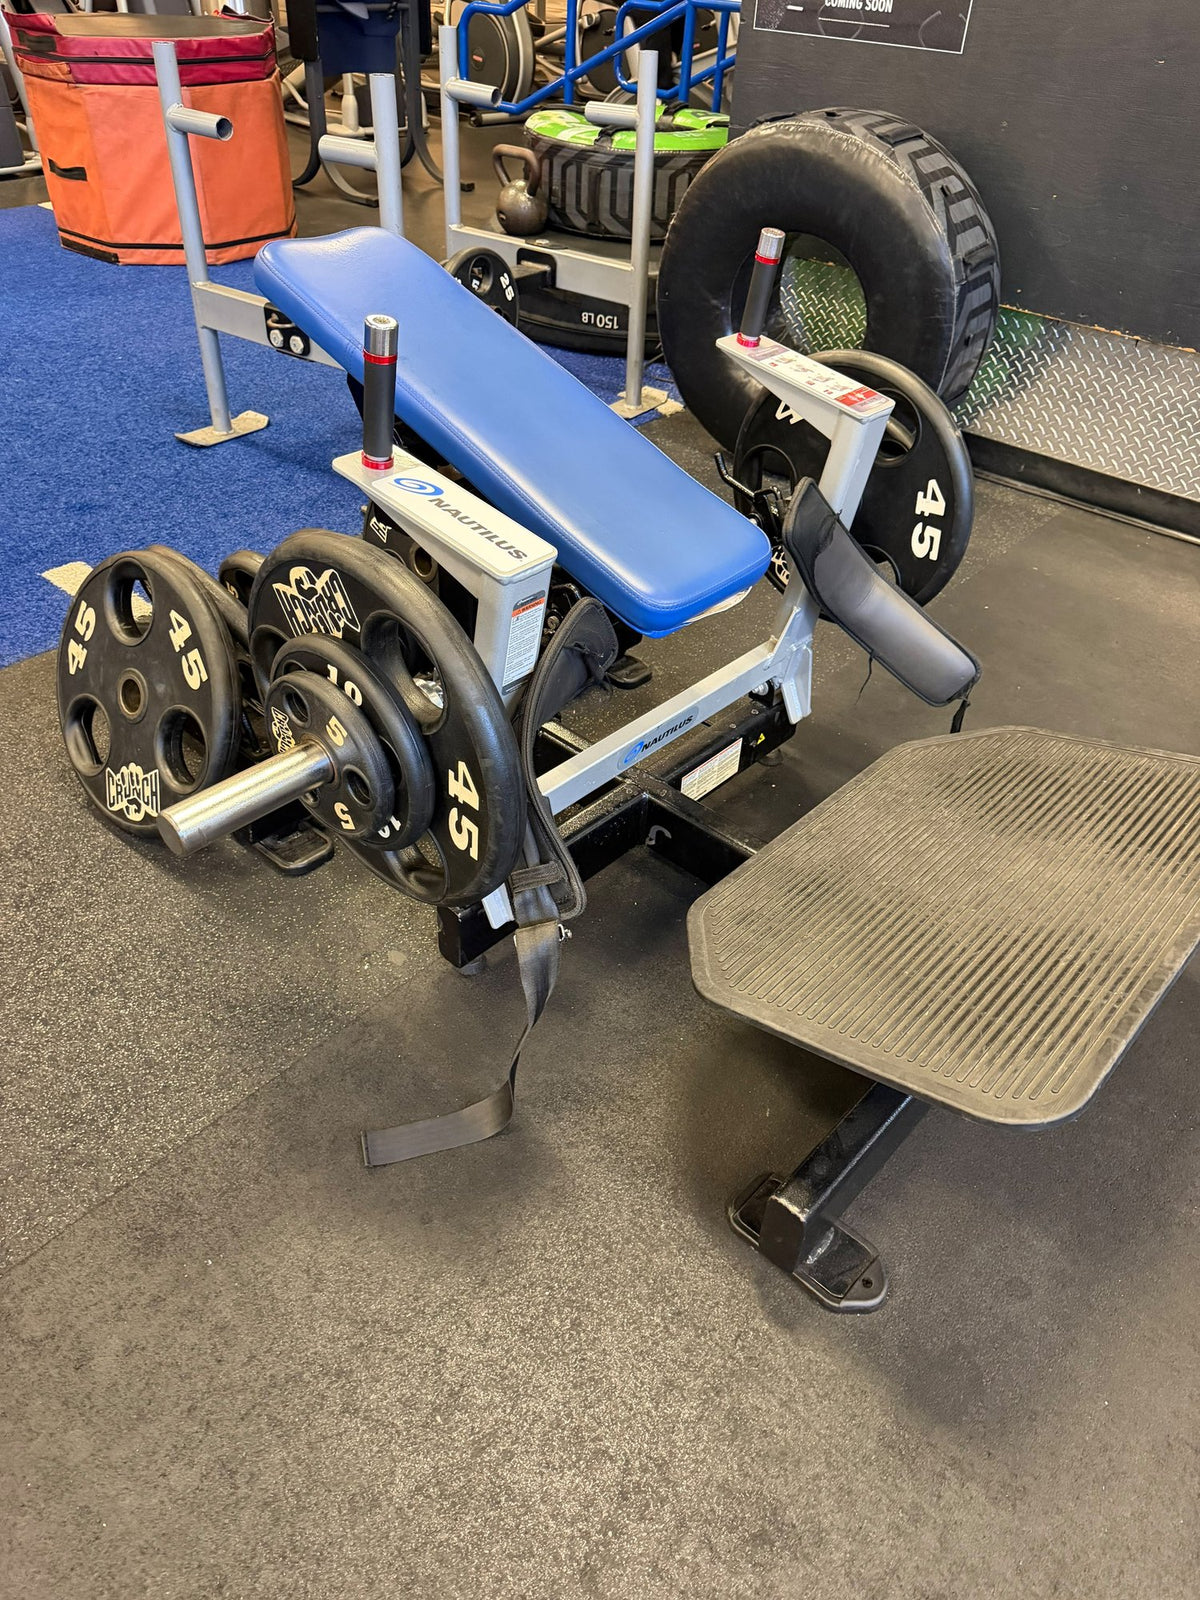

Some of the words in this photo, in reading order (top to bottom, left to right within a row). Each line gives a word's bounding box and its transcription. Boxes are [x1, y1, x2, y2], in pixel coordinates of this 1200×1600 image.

[865, 0, 893, 13] SOON
[499, 272, 515, 302] 25
[581, 311, 595, 324] LB
[596, 314, 619, 330] 150
[429, 497, 528, 560] NAUTILUS
[911, 478, 946, 561] 45
[67, 600, 96, 676] 45
[168, 609, 208, 690] 45
[326, 663, 363, 707] 10
[325, 715, 348, 747] 5
[640, 714, 694, 753] NAUTILUS
[106, 765, 161, 818] CRUNCH
[448, 760, 480, 861] 45
[333, 802, 356, 831] 5
